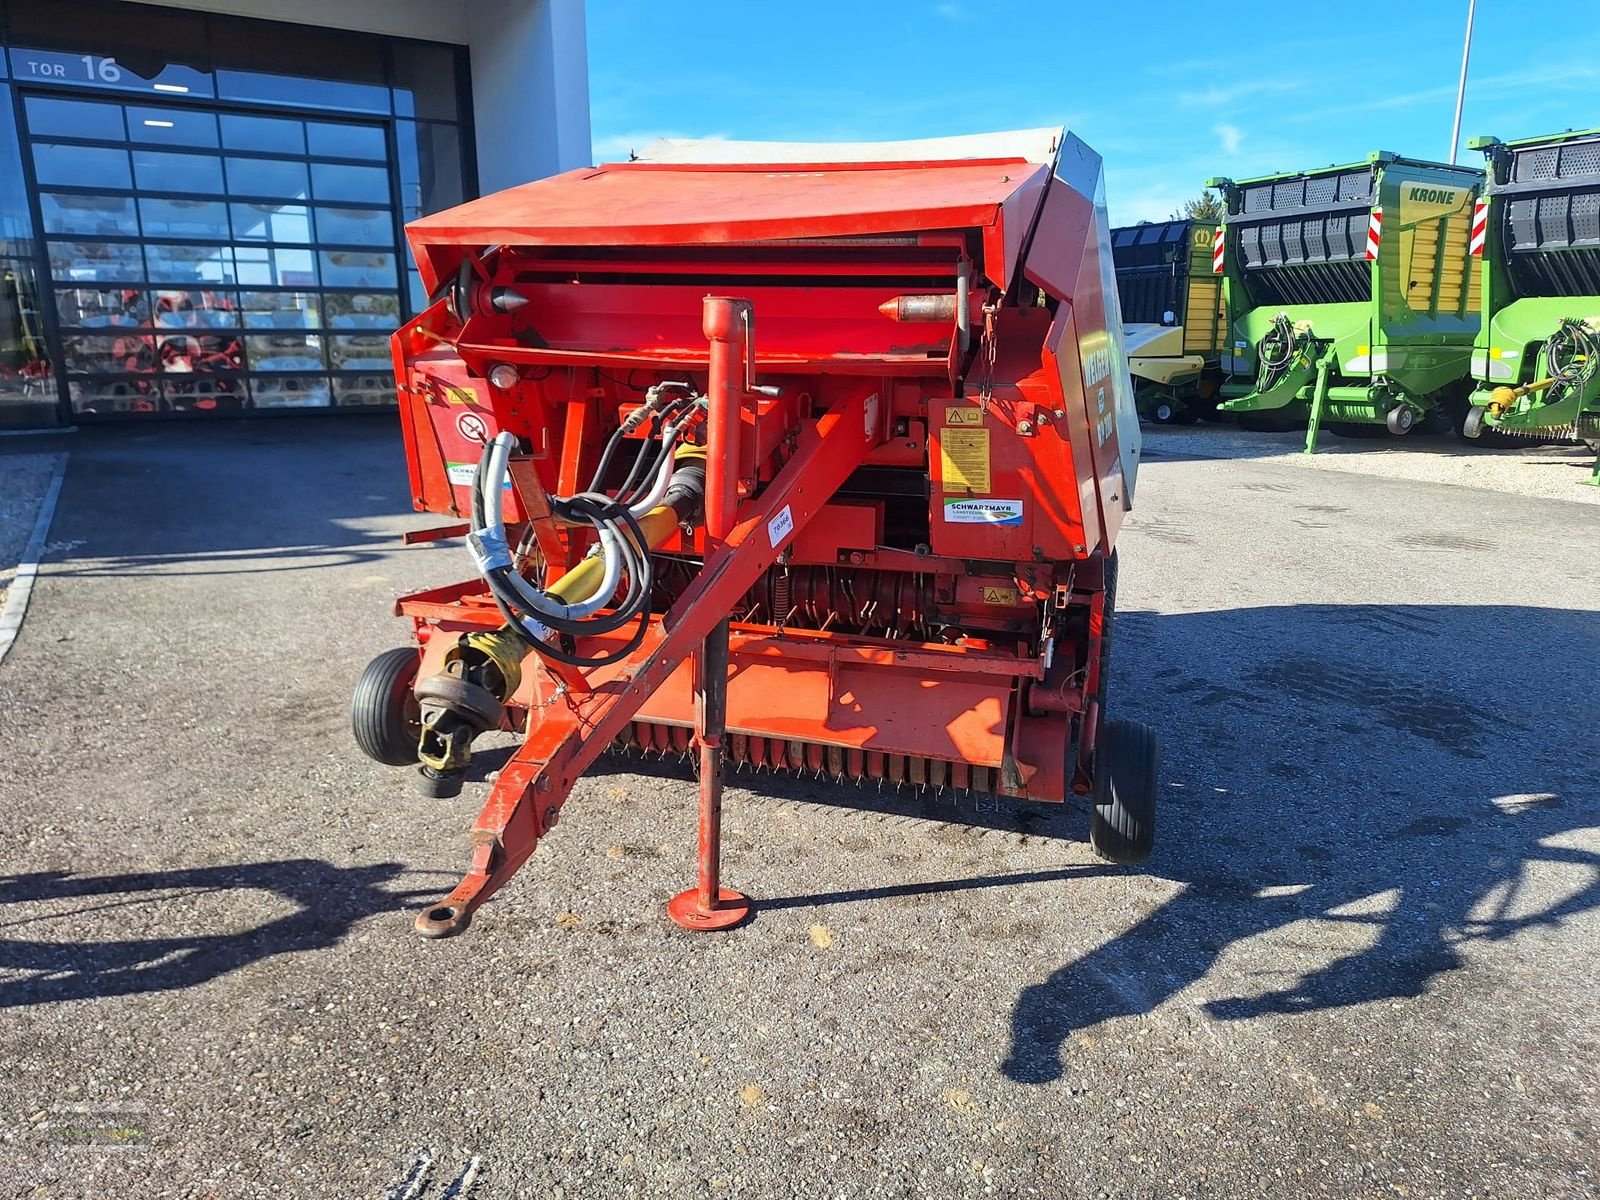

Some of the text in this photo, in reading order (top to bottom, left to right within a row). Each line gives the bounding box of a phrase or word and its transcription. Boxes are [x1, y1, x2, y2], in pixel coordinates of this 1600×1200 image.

[28, 55, 121, 82] TOR 16
[1408, 187, 1455, 205] KRONE
[951, 503, 1012, 511] SCHWARZMAYR
